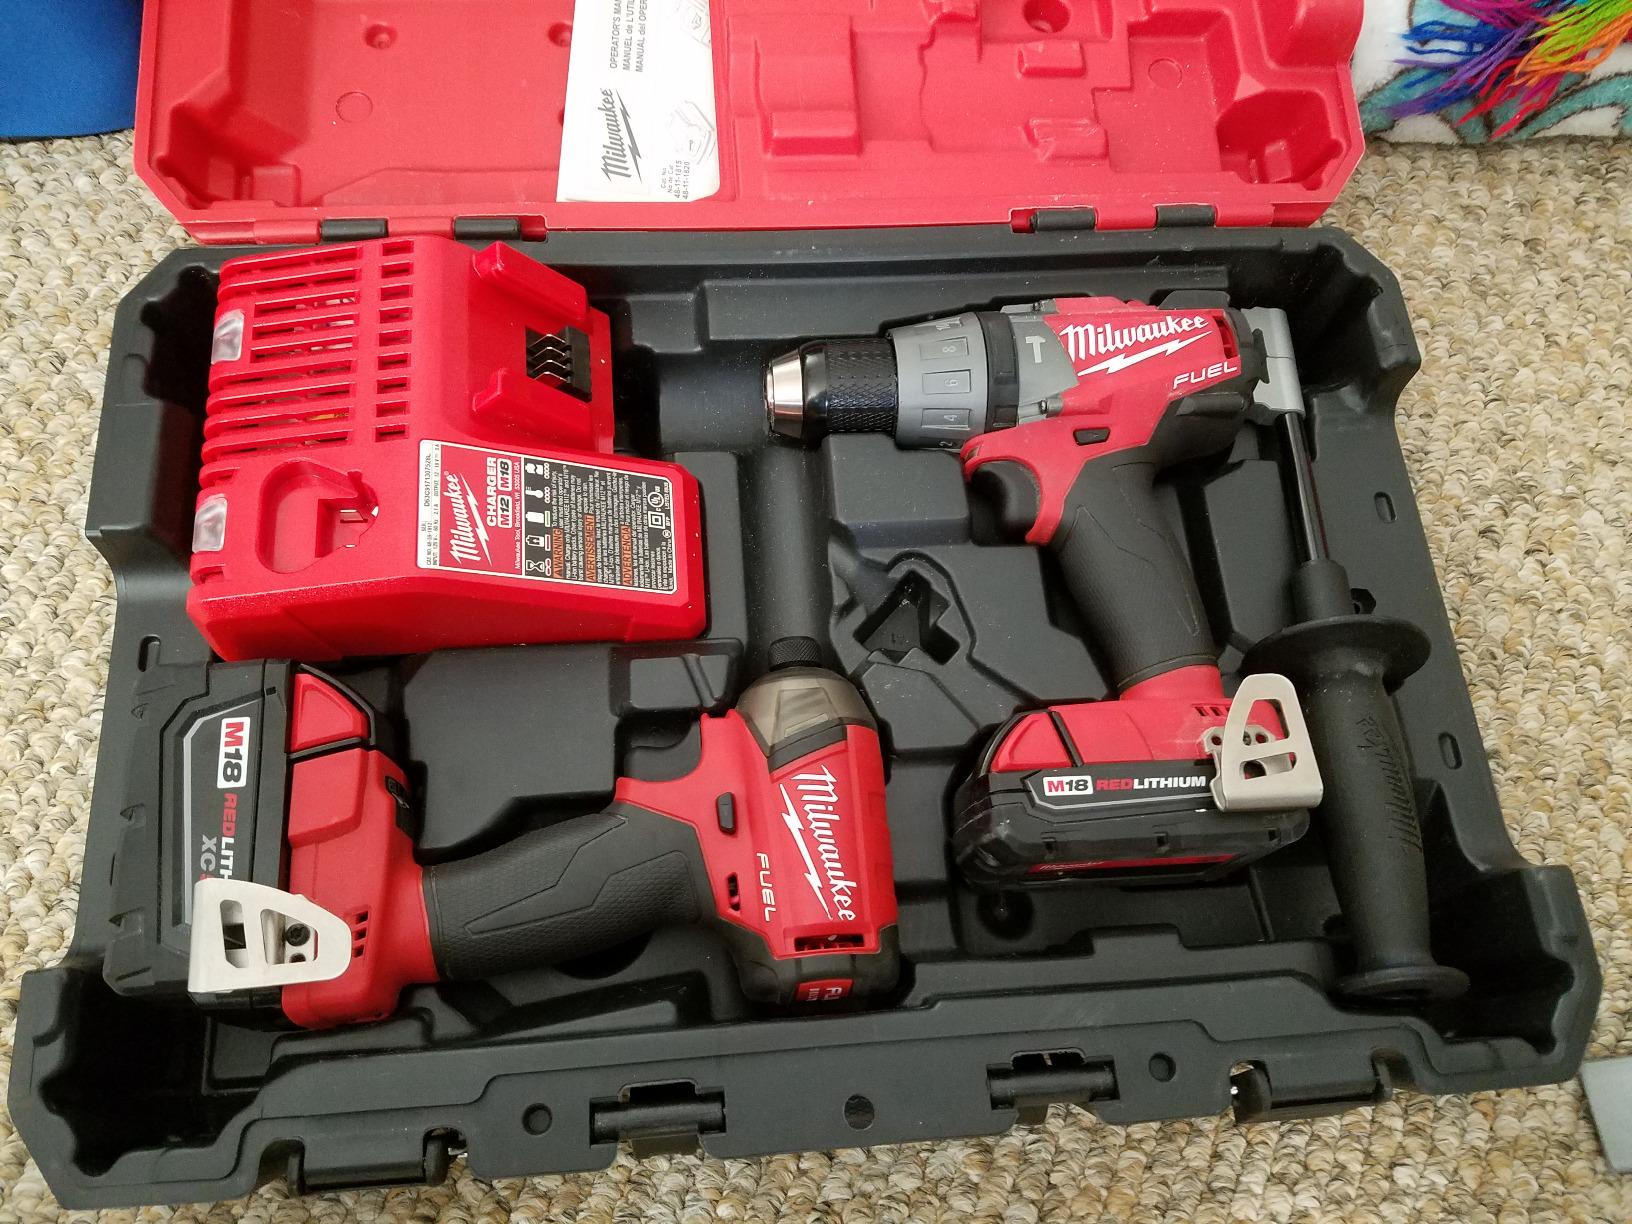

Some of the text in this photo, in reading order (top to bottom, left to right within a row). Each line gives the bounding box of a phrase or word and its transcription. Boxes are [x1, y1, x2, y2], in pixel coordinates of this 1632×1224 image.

[610, 16, 621, 69] OPERATOR'S
[623, 35, 632, 71] MANUEL
[626, 24, 633, 33] de
[636, 37, 645, 72] MANUAL
[598, 88, 632, 182] Milwaukee
[1059, 315, 1209, 363] Milwaukee
[1172, 361, 1238, 390] FUEL
[443, 473, 481, 564] Milwaukee
[486, 457, 497, 527] CHARGER
[500, 460, 510, 527] M12 M18
[554, 529, 562, 569] WARNING
[586, 515, 594, 580] AVERTISSEMENT
[622, 527, 631, 584] ADVERTENCIA
[223, 721, 245, 783] M18
[1047, 776, 1207, 793] M18 REDLITHIUM
[200, 834, 218, 872] XC
[791, 764, 858, 921] Milwaukee
[756, 852, 777, 922] FUEL
